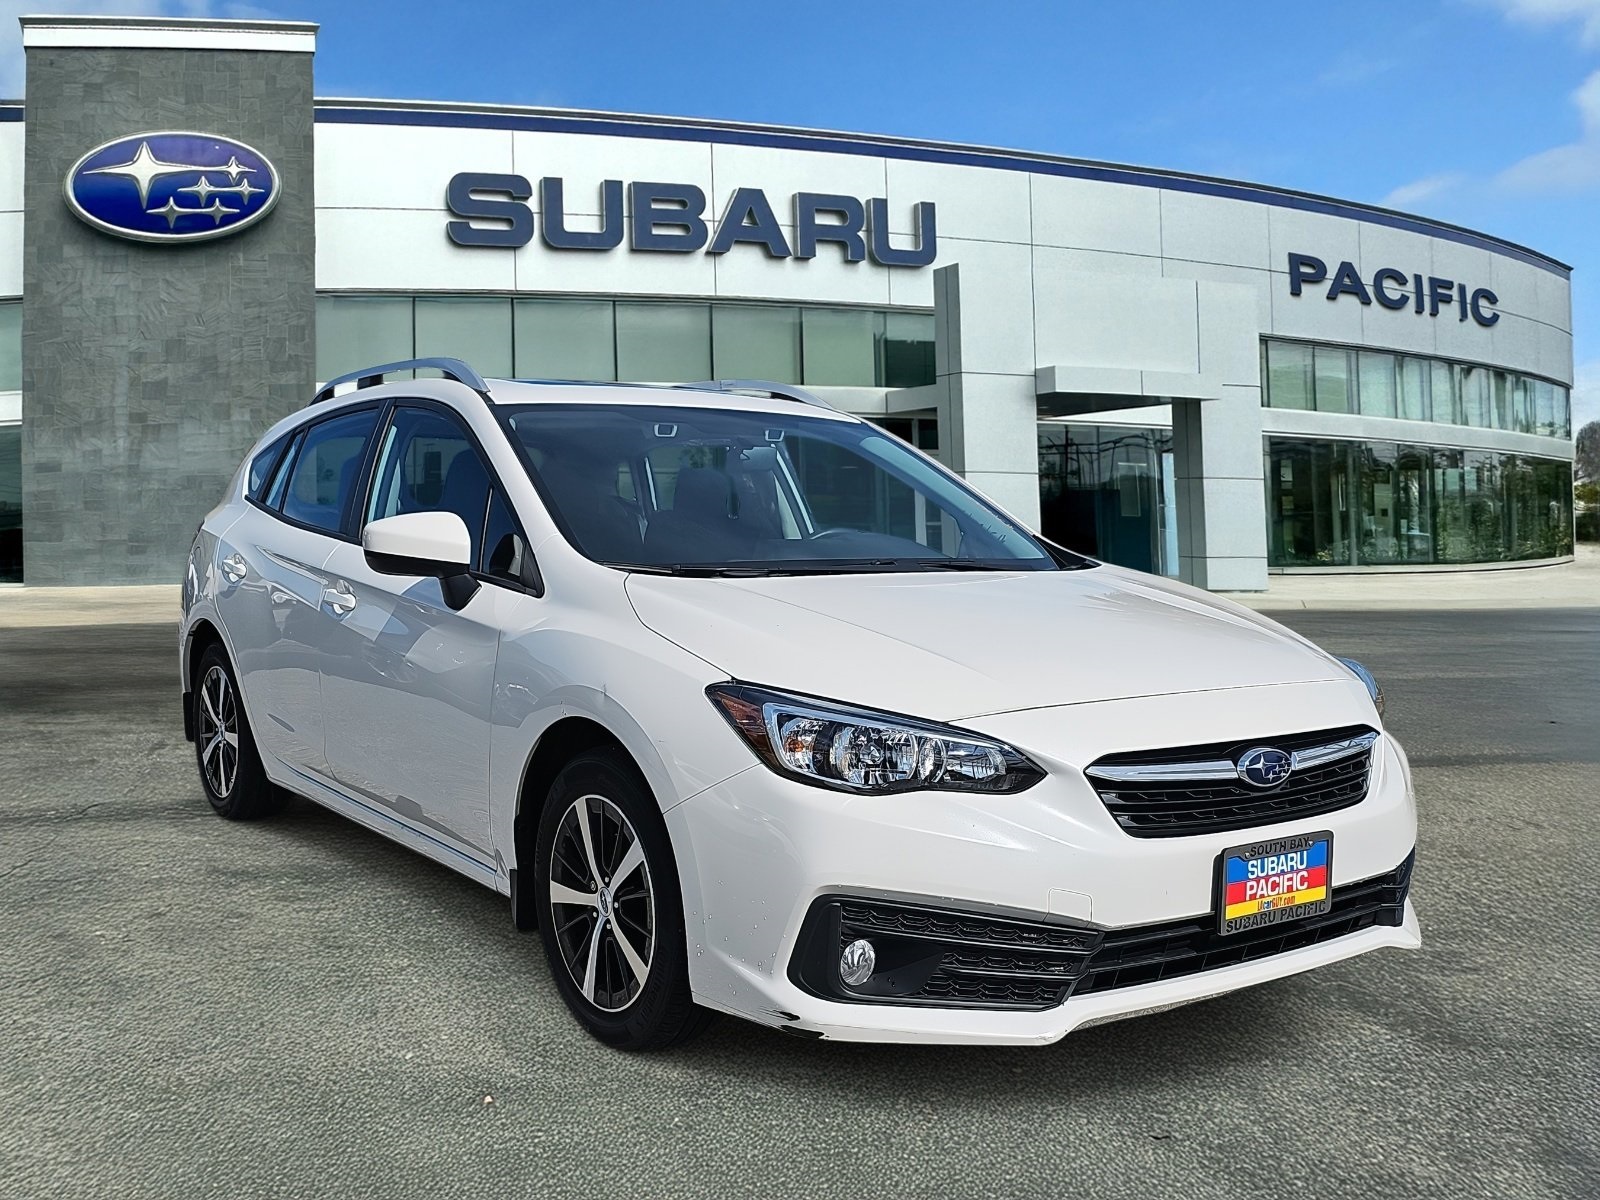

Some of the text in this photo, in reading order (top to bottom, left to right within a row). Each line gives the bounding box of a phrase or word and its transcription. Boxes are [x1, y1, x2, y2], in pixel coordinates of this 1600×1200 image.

[446, 171, 936, 267] SUBARU
[1288, 252, 1500, 327] PACIFIC
[1250, 837, 1309, 857] SOUTH BAY
[1248, 851, 1307, 879] SUBARU
[1246, 871, 1308, 901] PACIFIC
[1226, 901, 1326, 934] SUBARU PACIFIC
